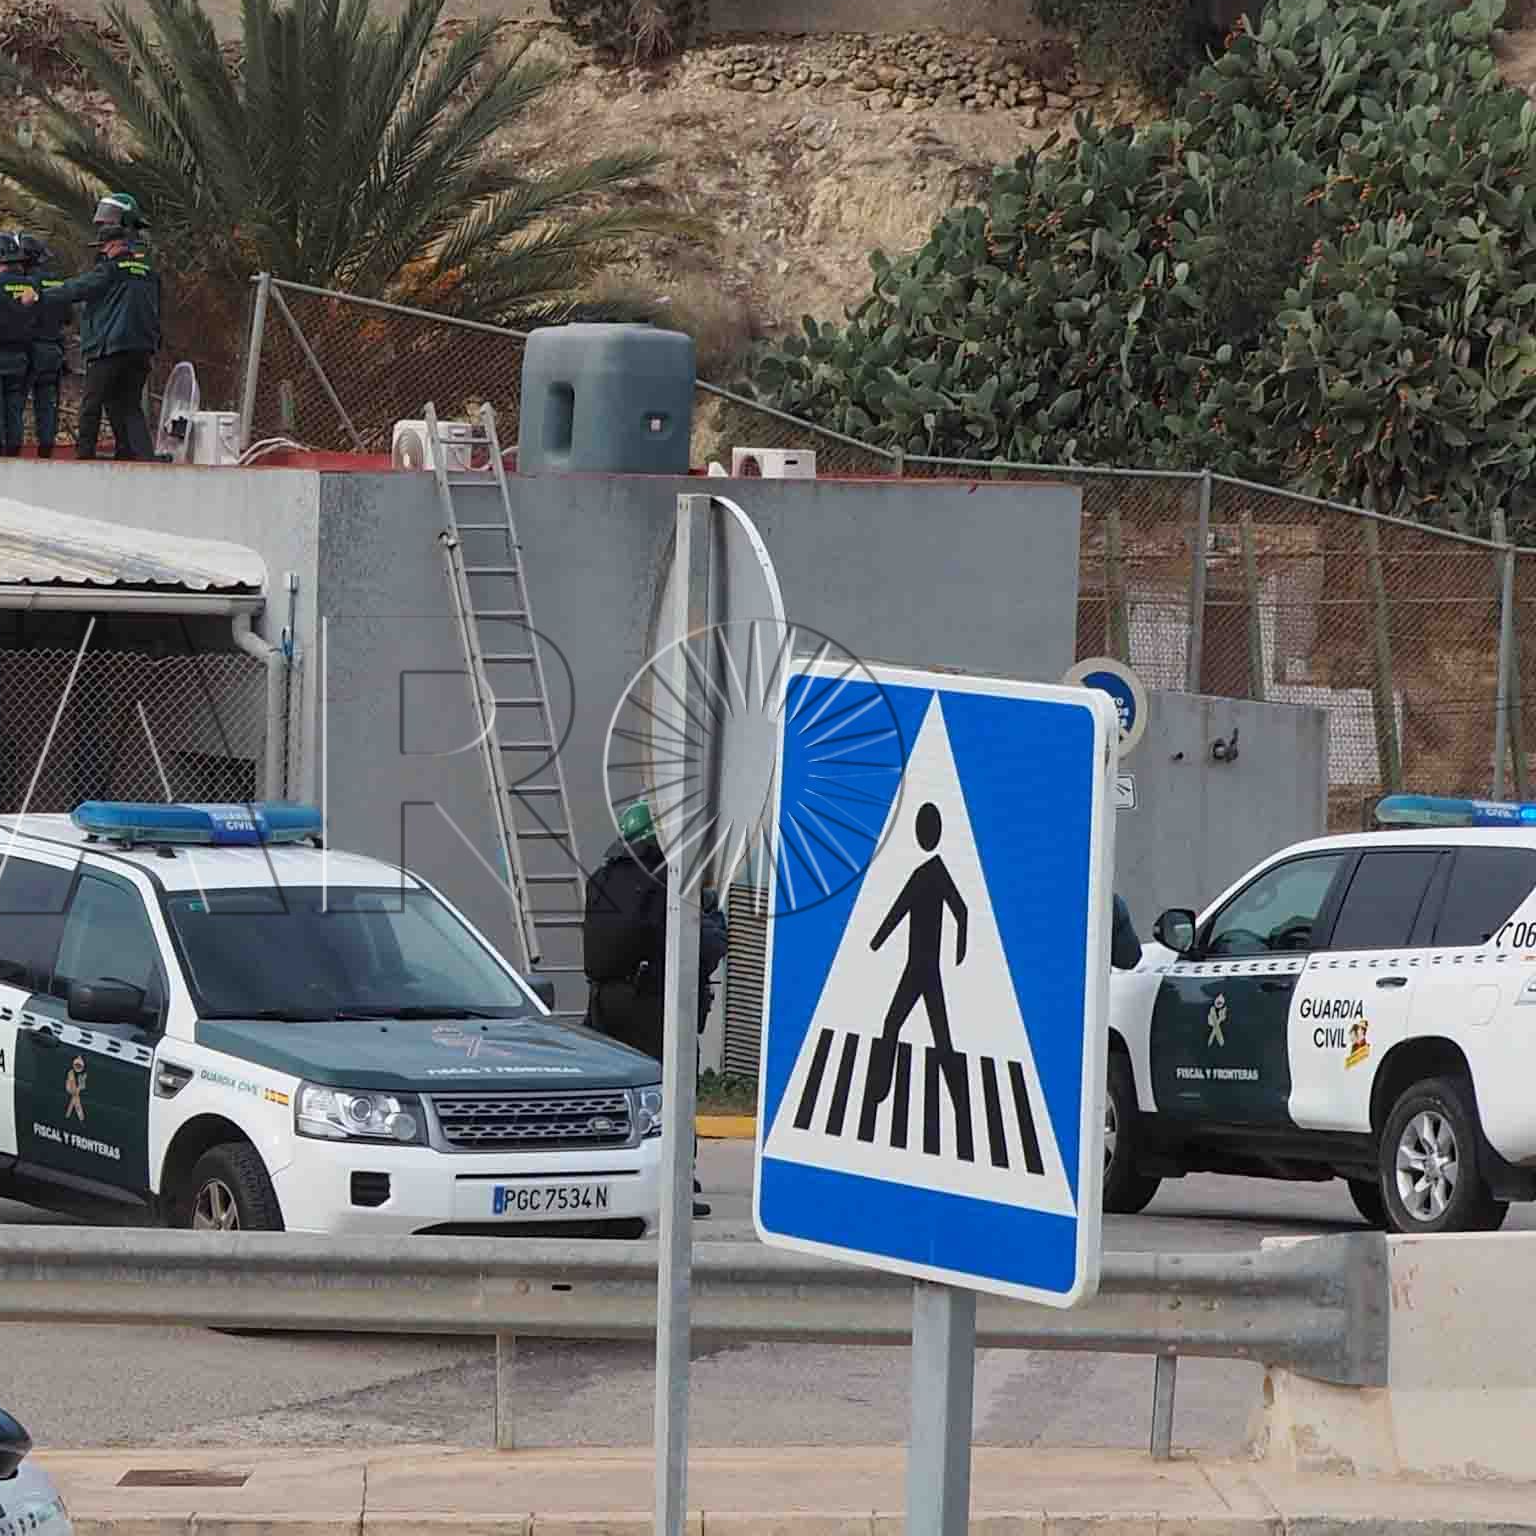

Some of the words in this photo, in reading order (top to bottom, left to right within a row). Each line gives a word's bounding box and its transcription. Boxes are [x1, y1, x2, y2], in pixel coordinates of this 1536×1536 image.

[1300, 998, 1364, 1020] GUARDIA
[1313, 1027, 1347, 1049] CIVIL
[1176, 1066, 1204, 1080] FISCAL
[1213, 1068, 1259, 1081] FRONTERAS
[33, 1122, 62, 1143] FISCAL
[71, 1133, 121, 1161] FRONTERAS
[504, 1188, 541, 1212] PGC
[545, 1186, 592, 1210] 7534
[595, 1183, 608, 1209] N
